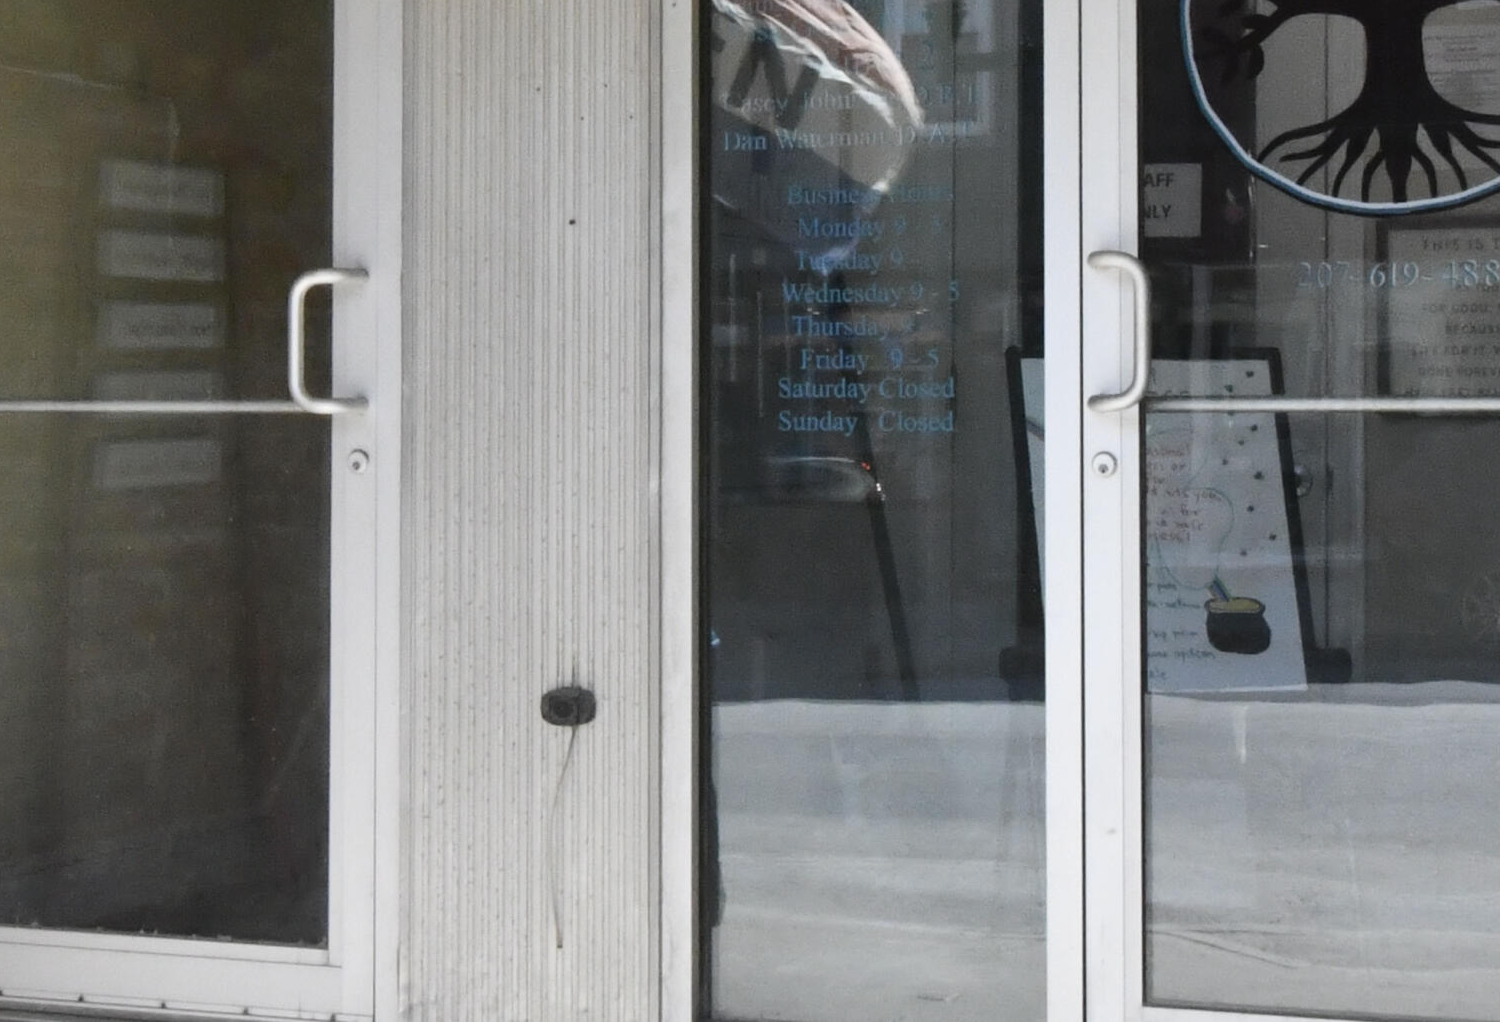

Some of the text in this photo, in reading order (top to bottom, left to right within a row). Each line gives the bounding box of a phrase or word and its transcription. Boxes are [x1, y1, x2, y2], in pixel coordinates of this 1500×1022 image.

[722, 129, 767, 152] Dan
[787, 183, 880, 207] Busine
[798, 216, 886, 244] Monday
[781, 280, 904, 308] Wednesday
[909, 282, 925, 301] 9
[948, 281, 961, 302] 5
[792, 314, 890, 342] Thursday
[800, 347, 871, 376] Friday
[890, 347, 905, 369] 9
[927, 348, 940, 369] 5
[777, 376, 955, 405] Saturday Closed
[777, 409, 955, 438] Sunday Closed
